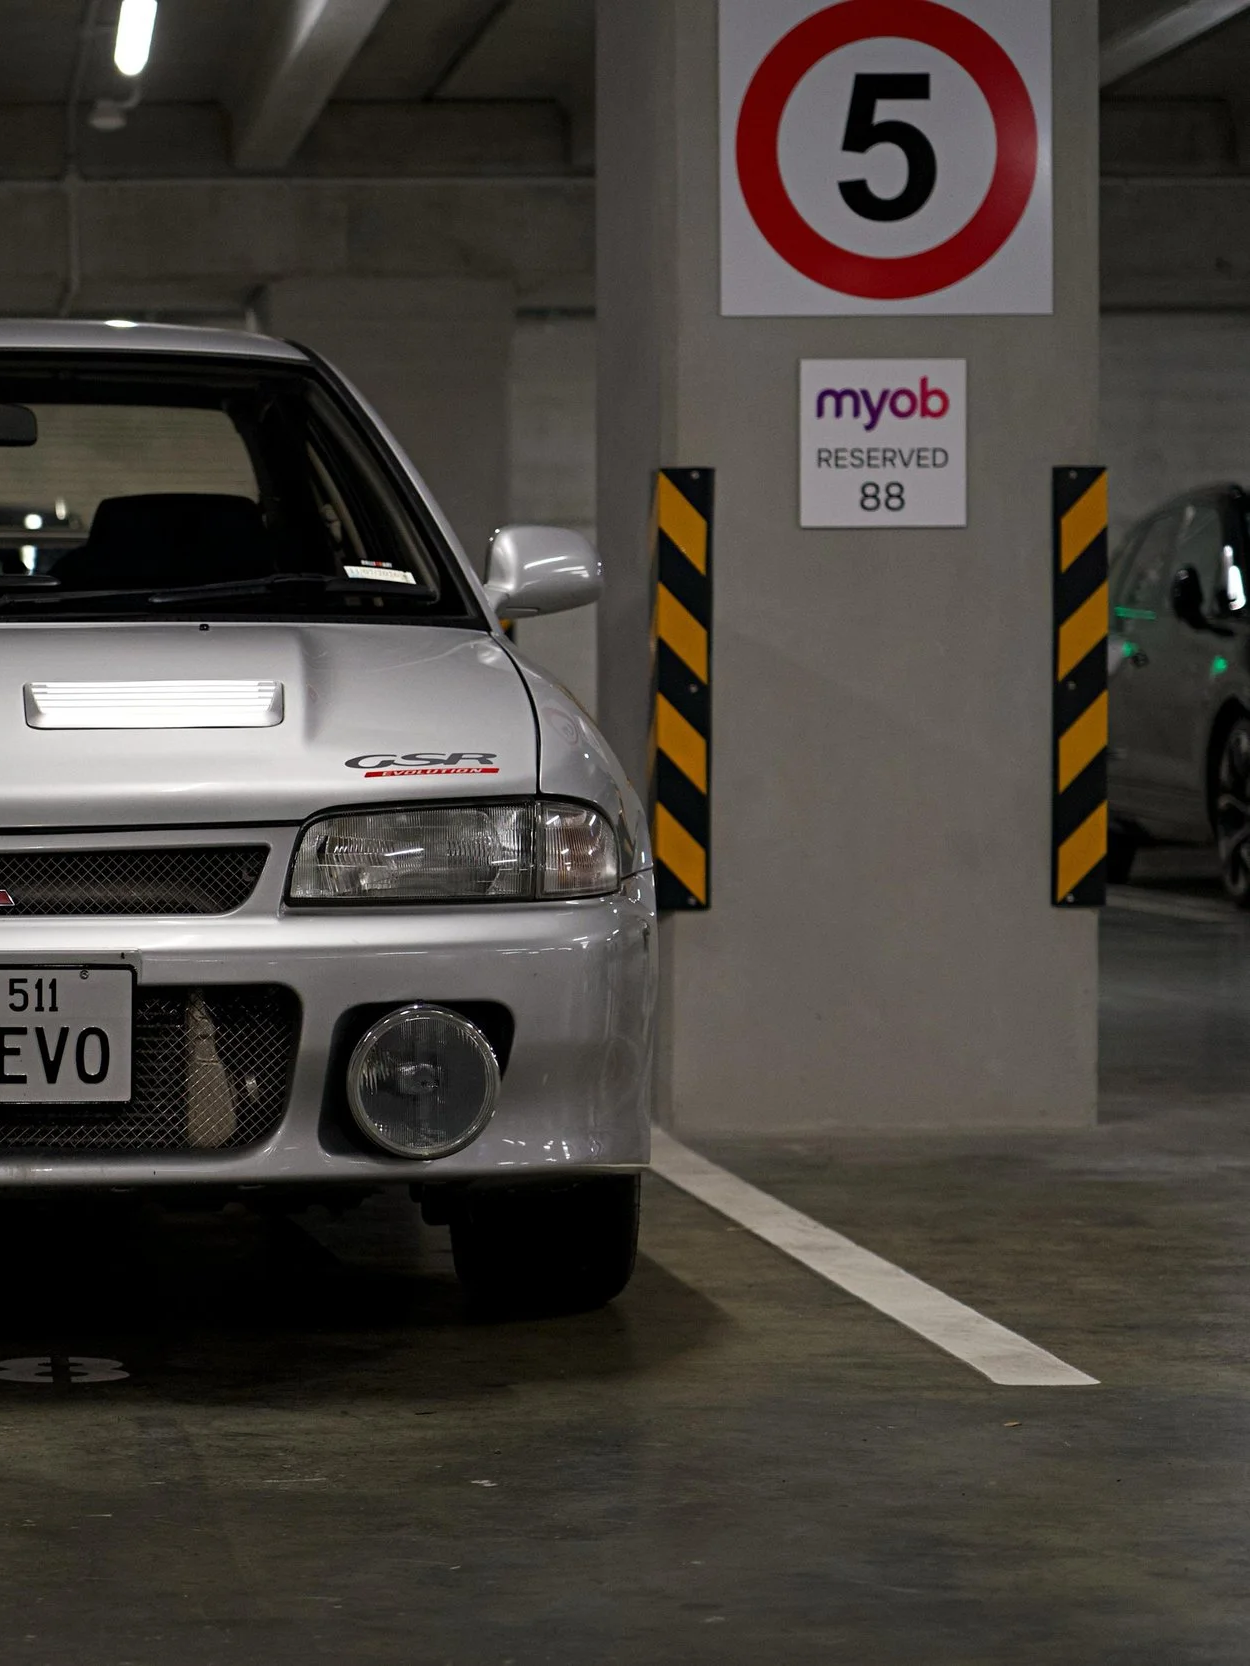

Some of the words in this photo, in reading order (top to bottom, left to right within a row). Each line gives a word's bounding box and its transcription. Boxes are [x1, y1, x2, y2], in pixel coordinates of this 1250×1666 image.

[838, 73, 938, 222] 5
[816, 376, 950, 431] myob
[817, 448, 949, 470] RESERVED
[859, 482, 906, 512] 88
[344, 752, 498, 769] GSR
[382, 768, 483, 777] EVOLUTION
[8, 978, 59, 1013] 511
